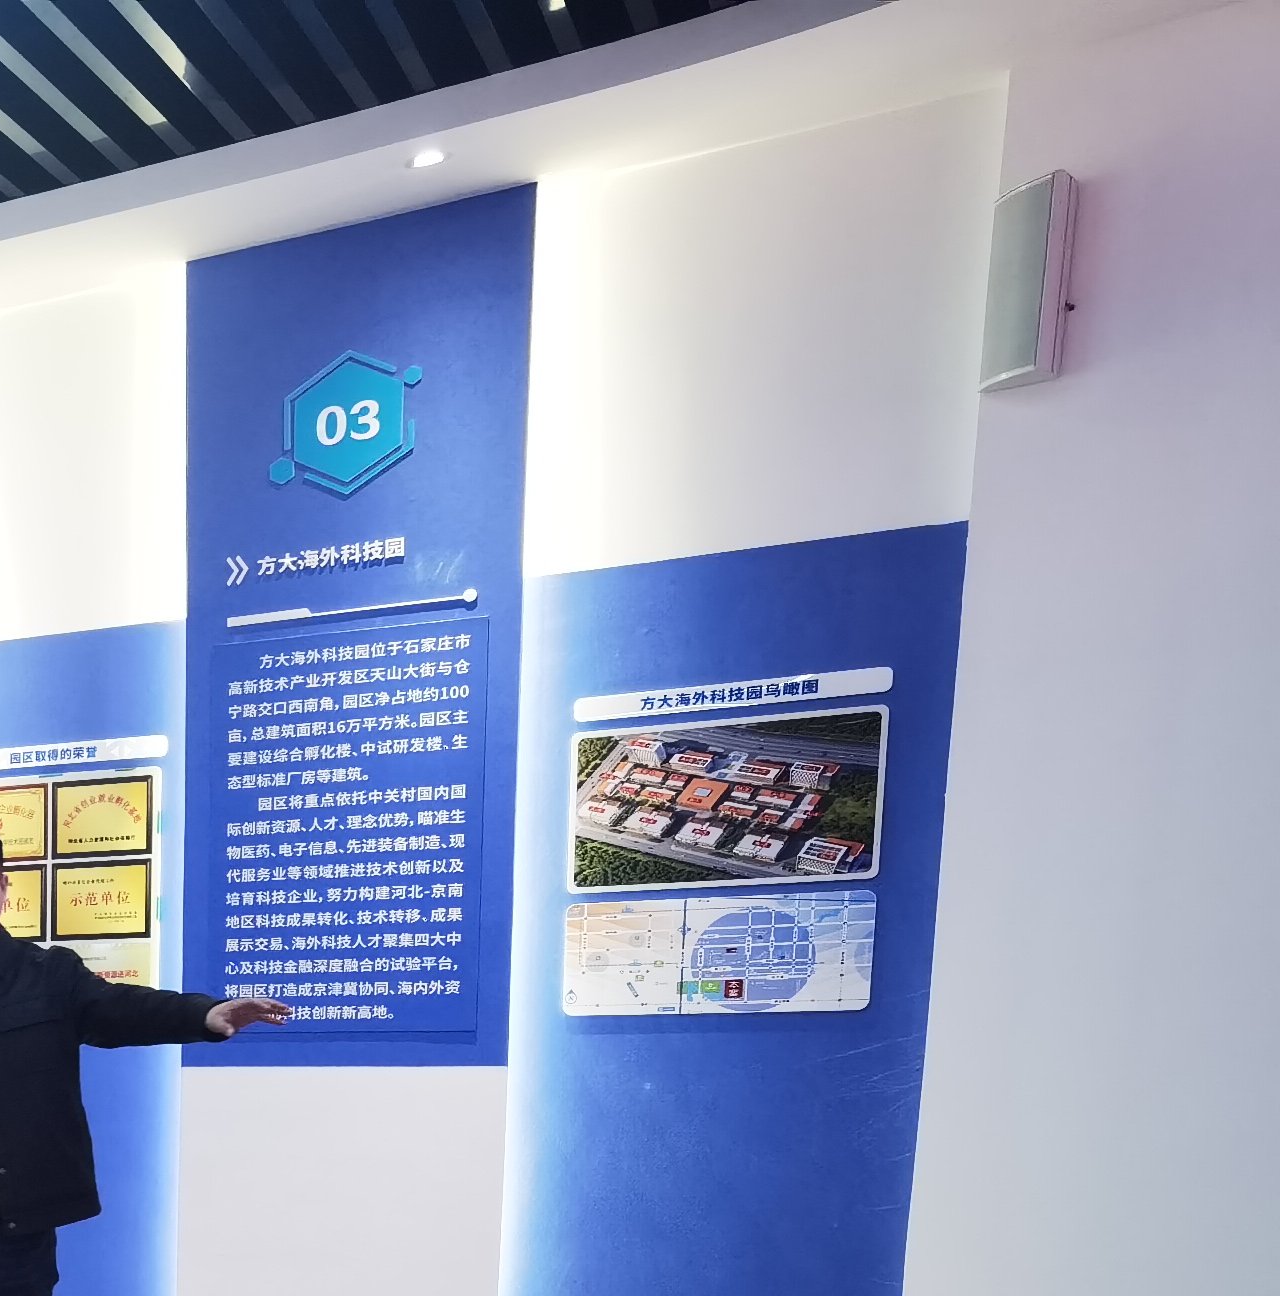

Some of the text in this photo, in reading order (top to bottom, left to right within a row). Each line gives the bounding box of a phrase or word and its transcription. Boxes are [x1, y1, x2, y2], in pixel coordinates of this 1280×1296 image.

[316, 399, 381, 446] 03
[257, 537, 405, 576] 方大海外科技园
[259, 633, 471, 670] 方大海外科技园位于石家庄市
[228, 659, 471, 696] 高新技术产业开发区天山大街与仓
[640, 678, 819, 711] 方大海外科技园鸟瞰图
[10, 746, 98, 764] 园区取得的荣誉
[227, 734, 468, 767] 要建设综合孵化楼、中试研发楼、生
[227, 768, 369, 790] 态型标准厂房等建筑。
[257, 784, 466, 812] 园区将重点依托中关村国内国
[226, 834, 465, 860] 物医药、电子信息、先进装备制造、现
[226, 858, 464, 883] 代服务业等领域推进技术创新以及
[70, 890, 131, 906] 示范单位
[225, 907, 463, 929] 地区科技成果转化、技术转移、成果
[225, 932, 462, 953] 展示交易、海外科技人才聚集四大中
[224, 980, 461, 998] 将园区打造成京津冀协同、海内外资
